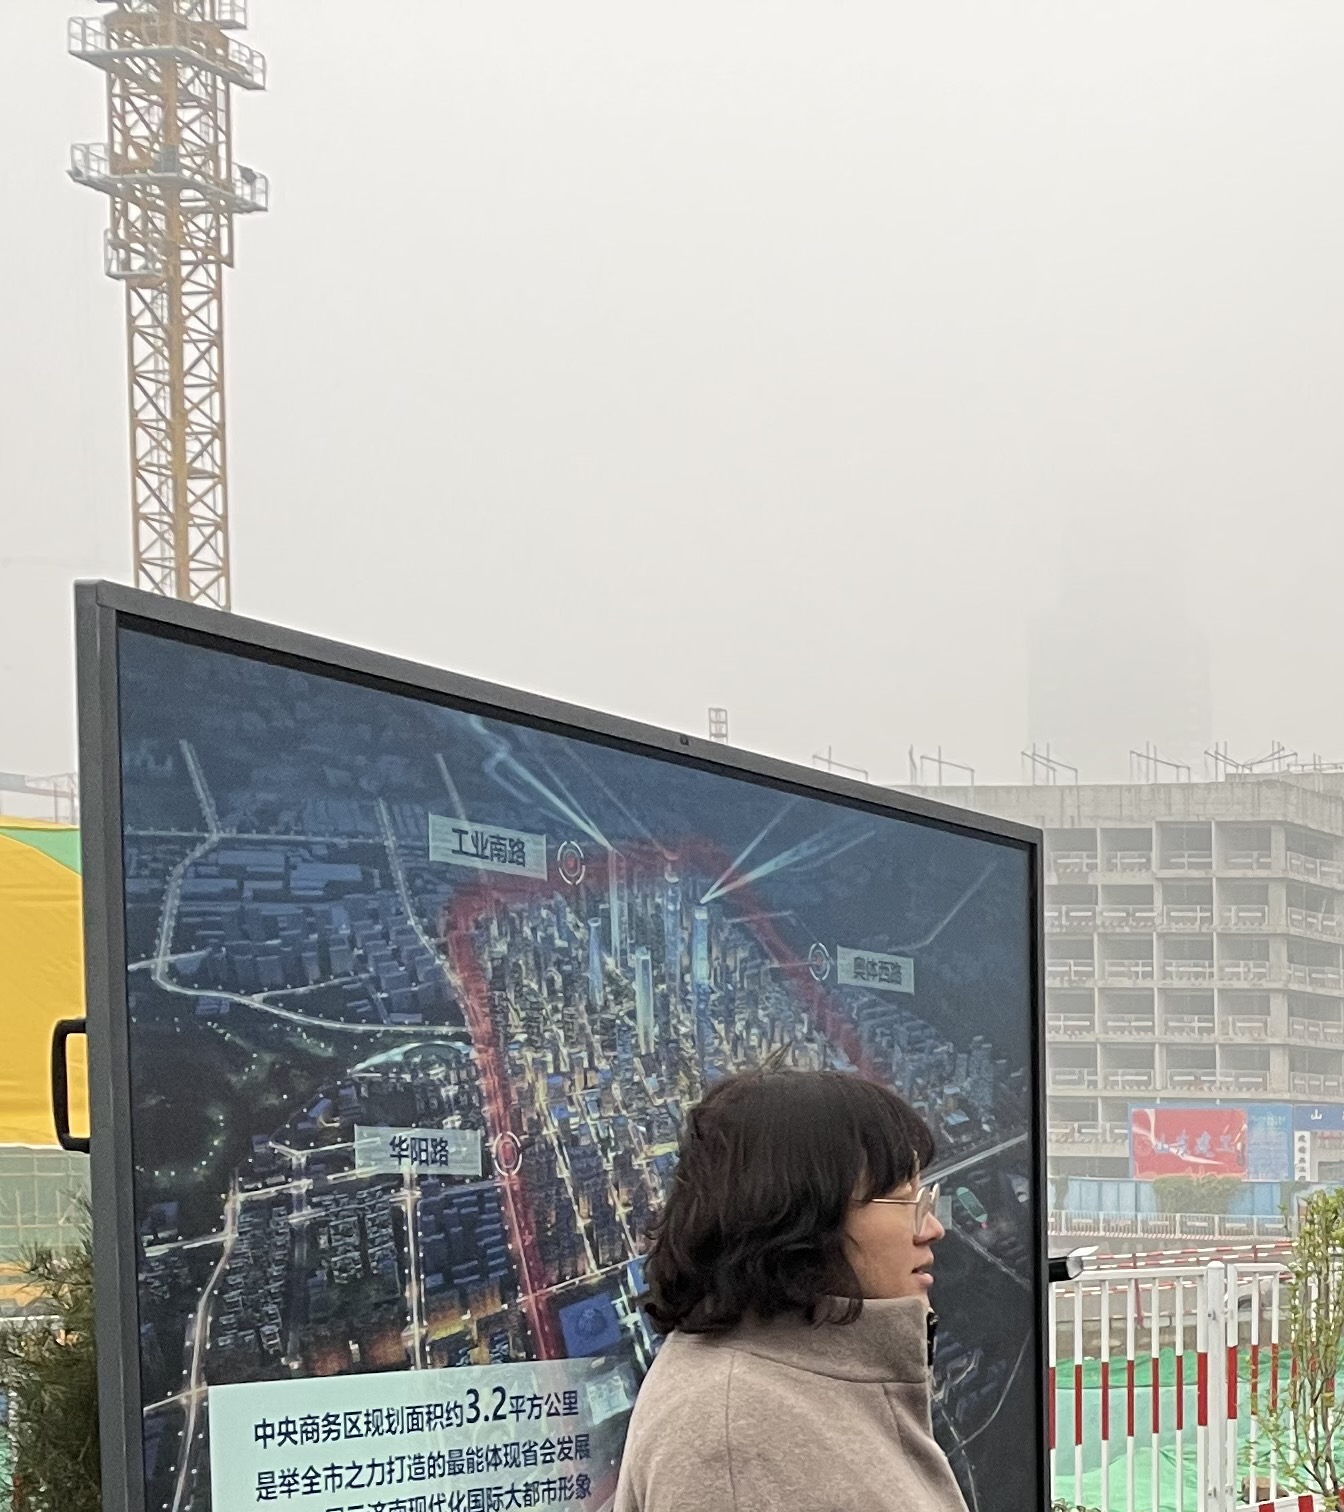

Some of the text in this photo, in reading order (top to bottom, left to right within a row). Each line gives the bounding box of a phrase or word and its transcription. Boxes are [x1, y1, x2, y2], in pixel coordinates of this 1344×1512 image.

[451, 827, 526, 867] 工业南路
[853, 956, 902, 985] 奥体西路
[389, 1135, 449, 1167] 华阳路
[253, 1386, 580, 1450] 中央商务区规划面积约3.2平方公里
[255, 1433, 592, 1503] 是举全市之力打造的最能体现省会发展
